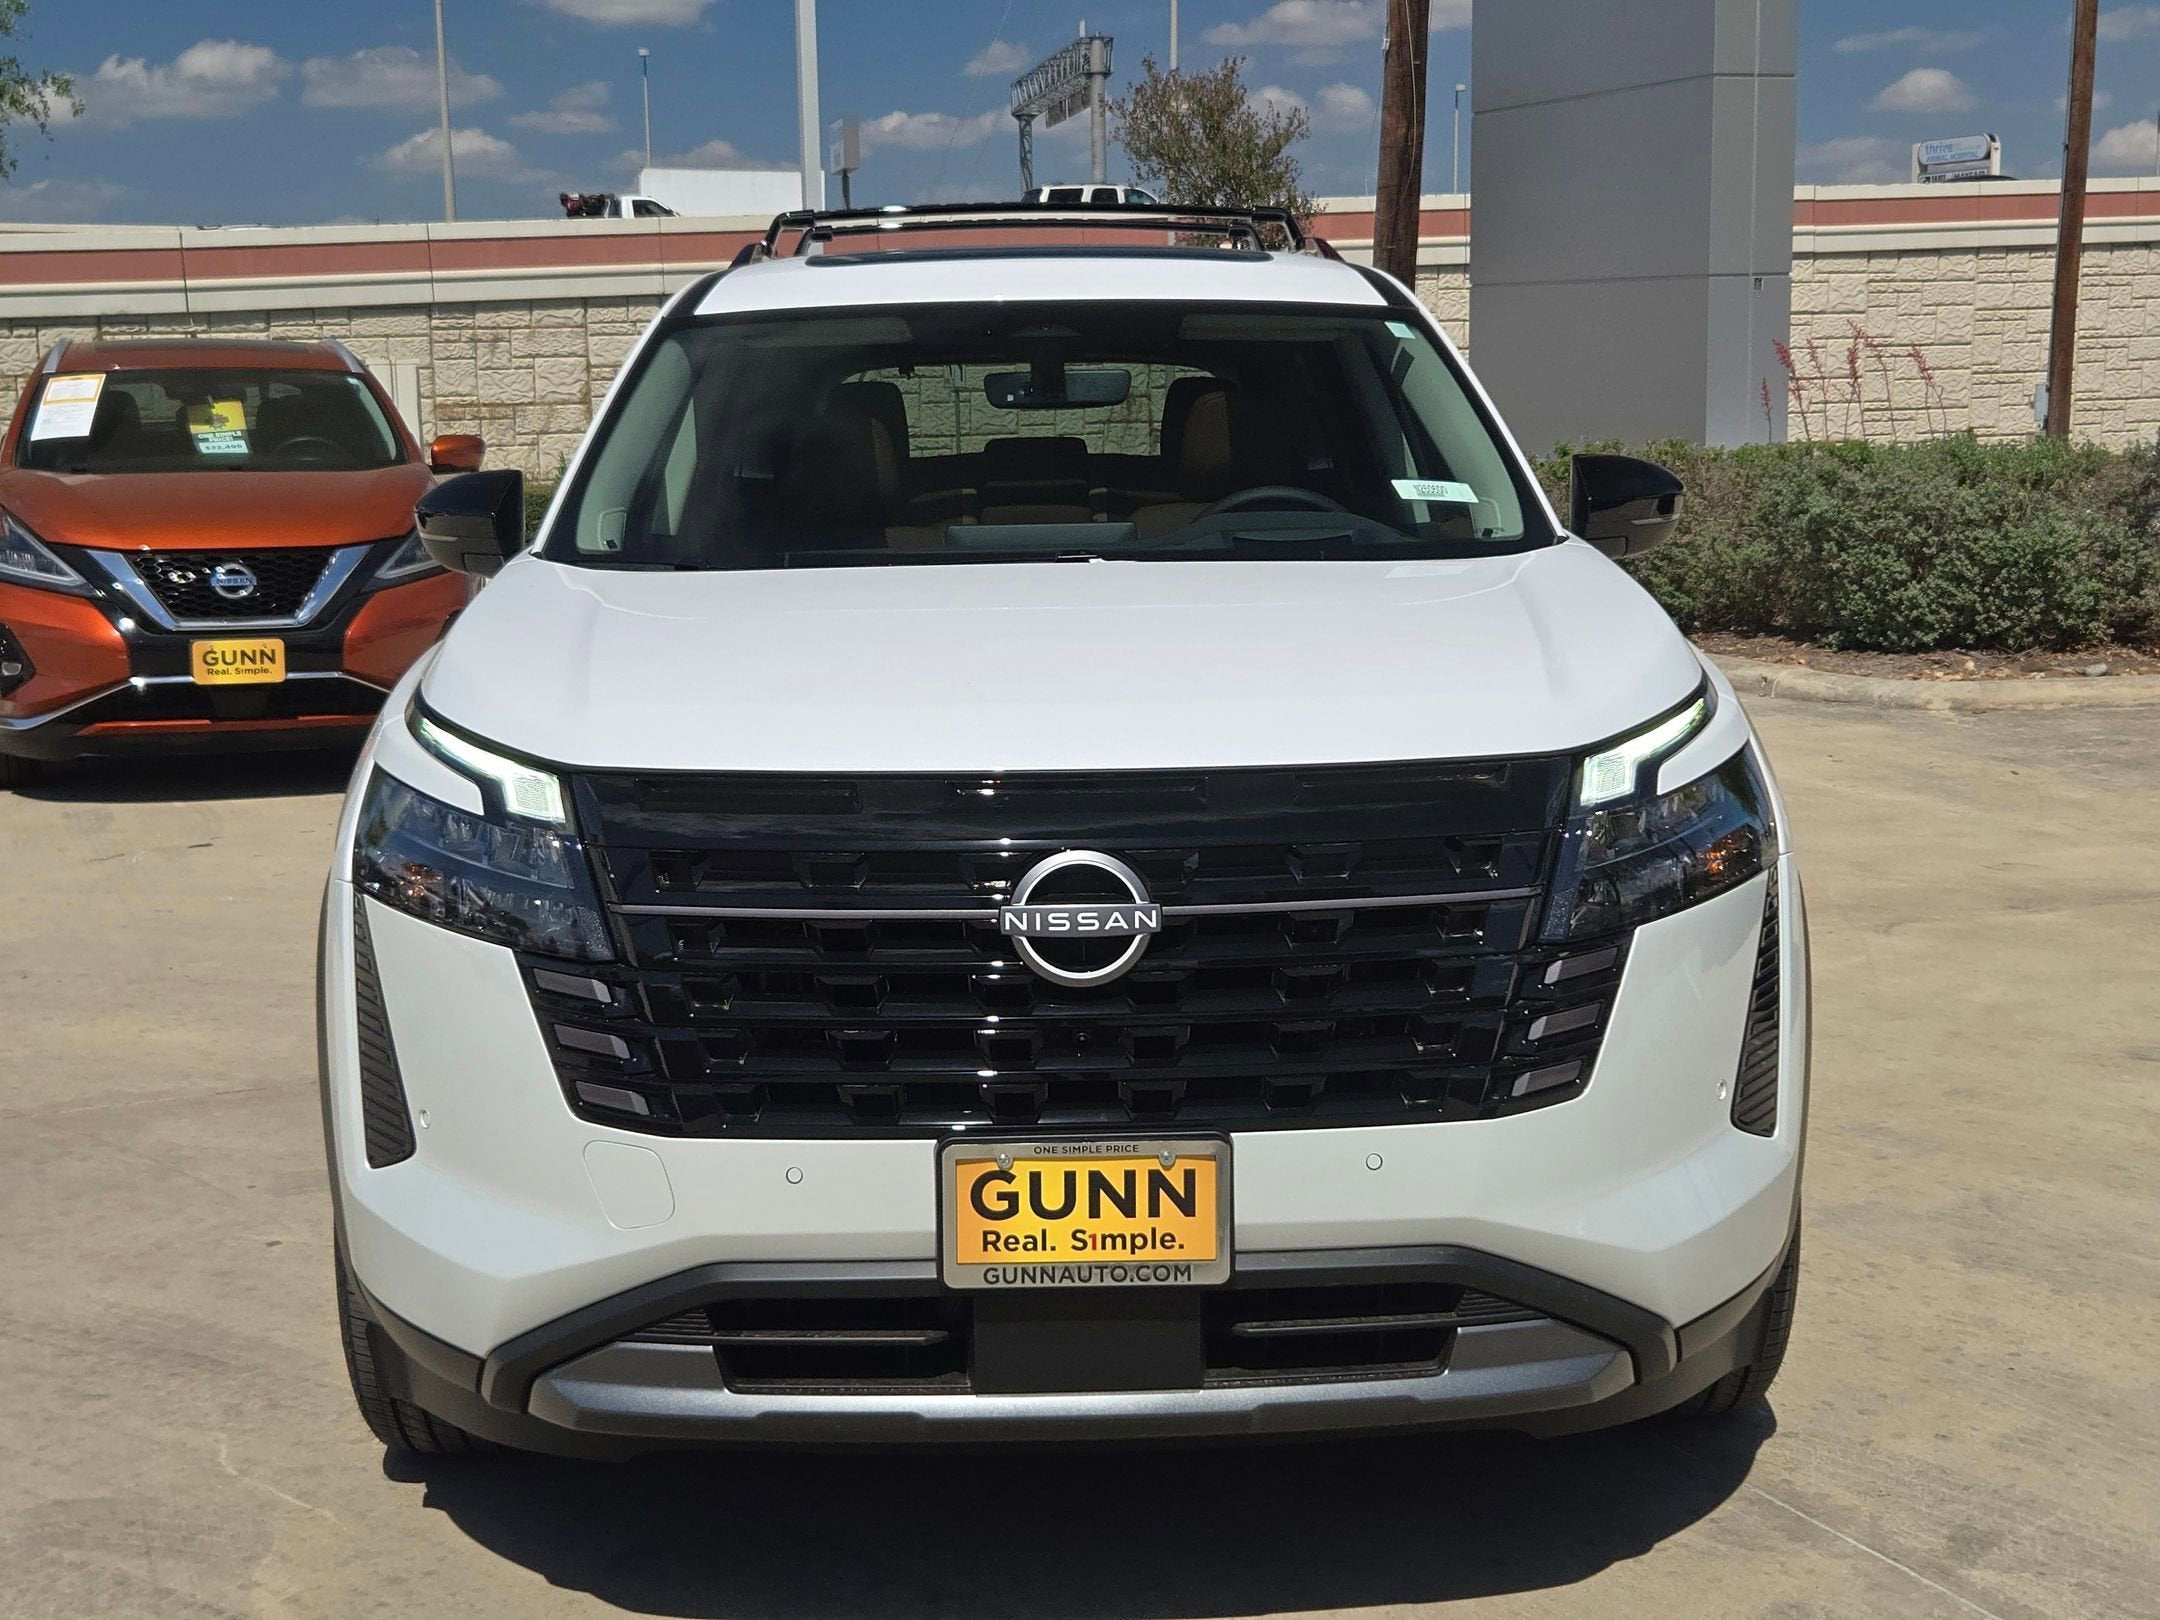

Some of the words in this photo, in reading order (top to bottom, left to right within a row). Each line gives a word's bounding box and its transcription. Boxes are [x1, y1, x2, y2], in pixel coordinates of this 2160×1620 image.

[1926, 141, 1953, 154] thrive
[1950, 150, 1979, 160] HOSPITAL
[216, 577, 253, 586] NISSAN
[202, 648, 277, 666] GUNN
[207, 667, 232, 676] Real.
[1005, 909, 1158, 932] NISSAN
[1033, 1145, 1058, 1155] ONE
[1061, 1144, 1103, 1154] SIMPLE
[1106, 1144, 1140, 1153] PRICE
[970, 1168, 1196, 1221] GUNN
[982, 1228, 1057, 1252] Real.
[983, 1264, 1192, 1285] GUNNAUTO.COM
